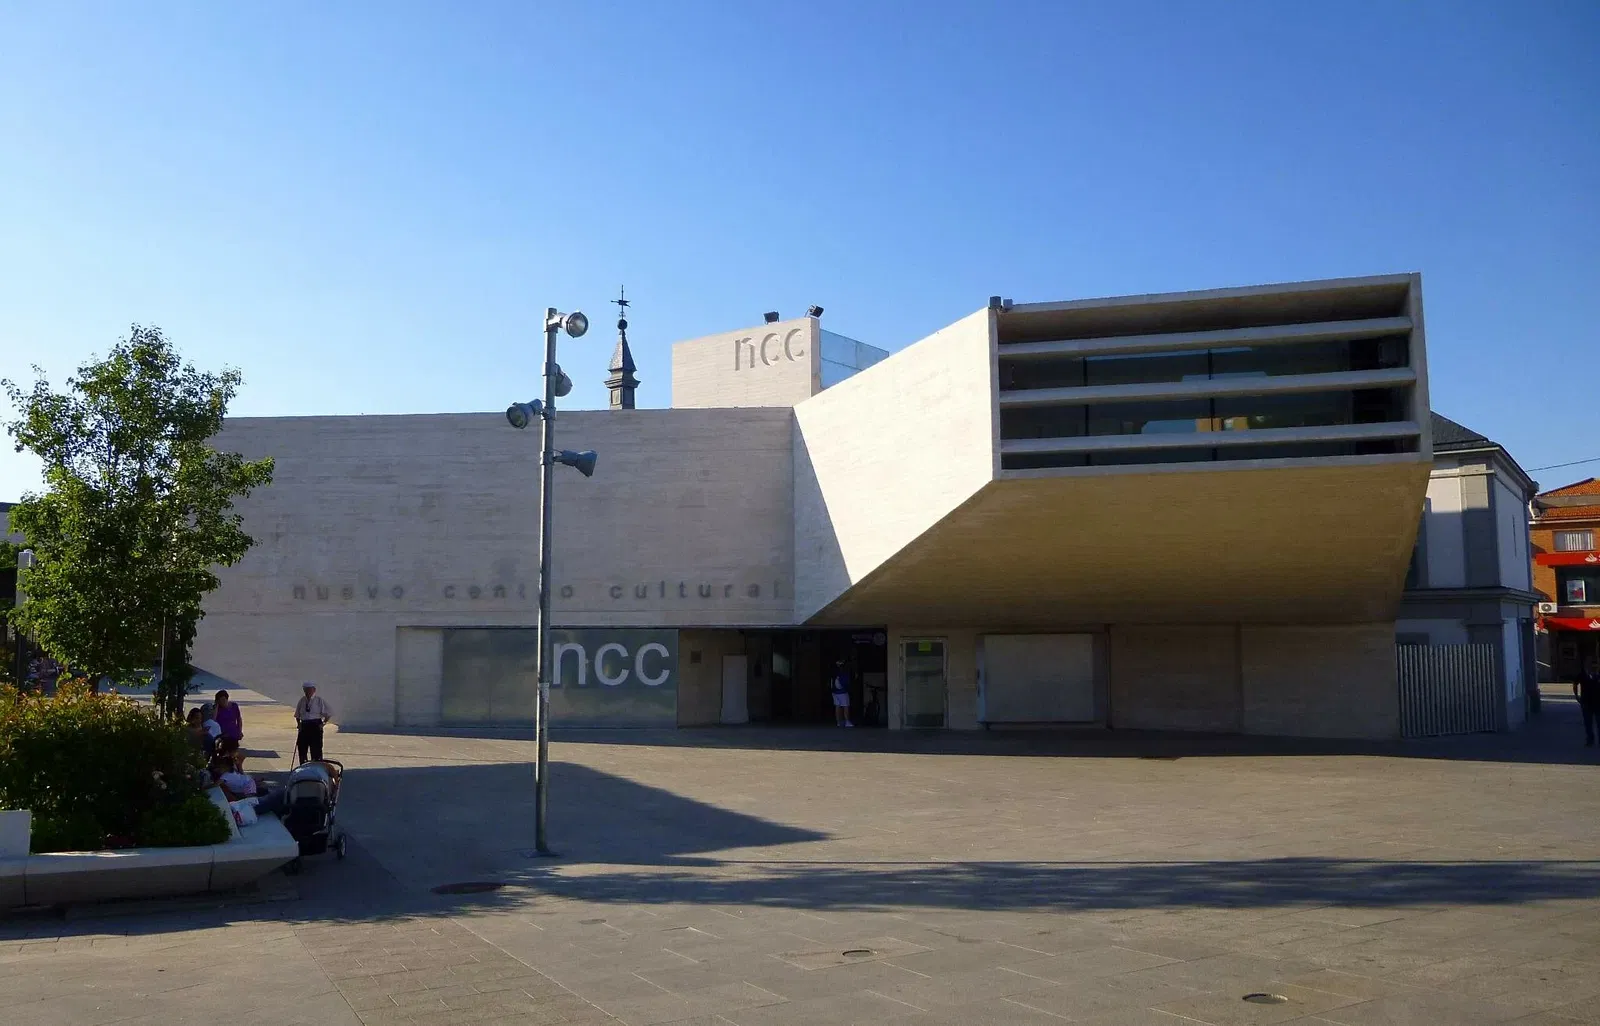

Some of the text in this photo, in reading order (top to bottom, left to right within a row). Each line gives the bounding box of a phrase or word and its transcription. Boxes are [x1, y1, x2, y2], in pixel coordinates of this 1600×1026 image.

[735, 328, 804, 371] ncc
[293, 579, 784, 600] nuevo cento cultural
[553, 642, 670, 686] ncc
